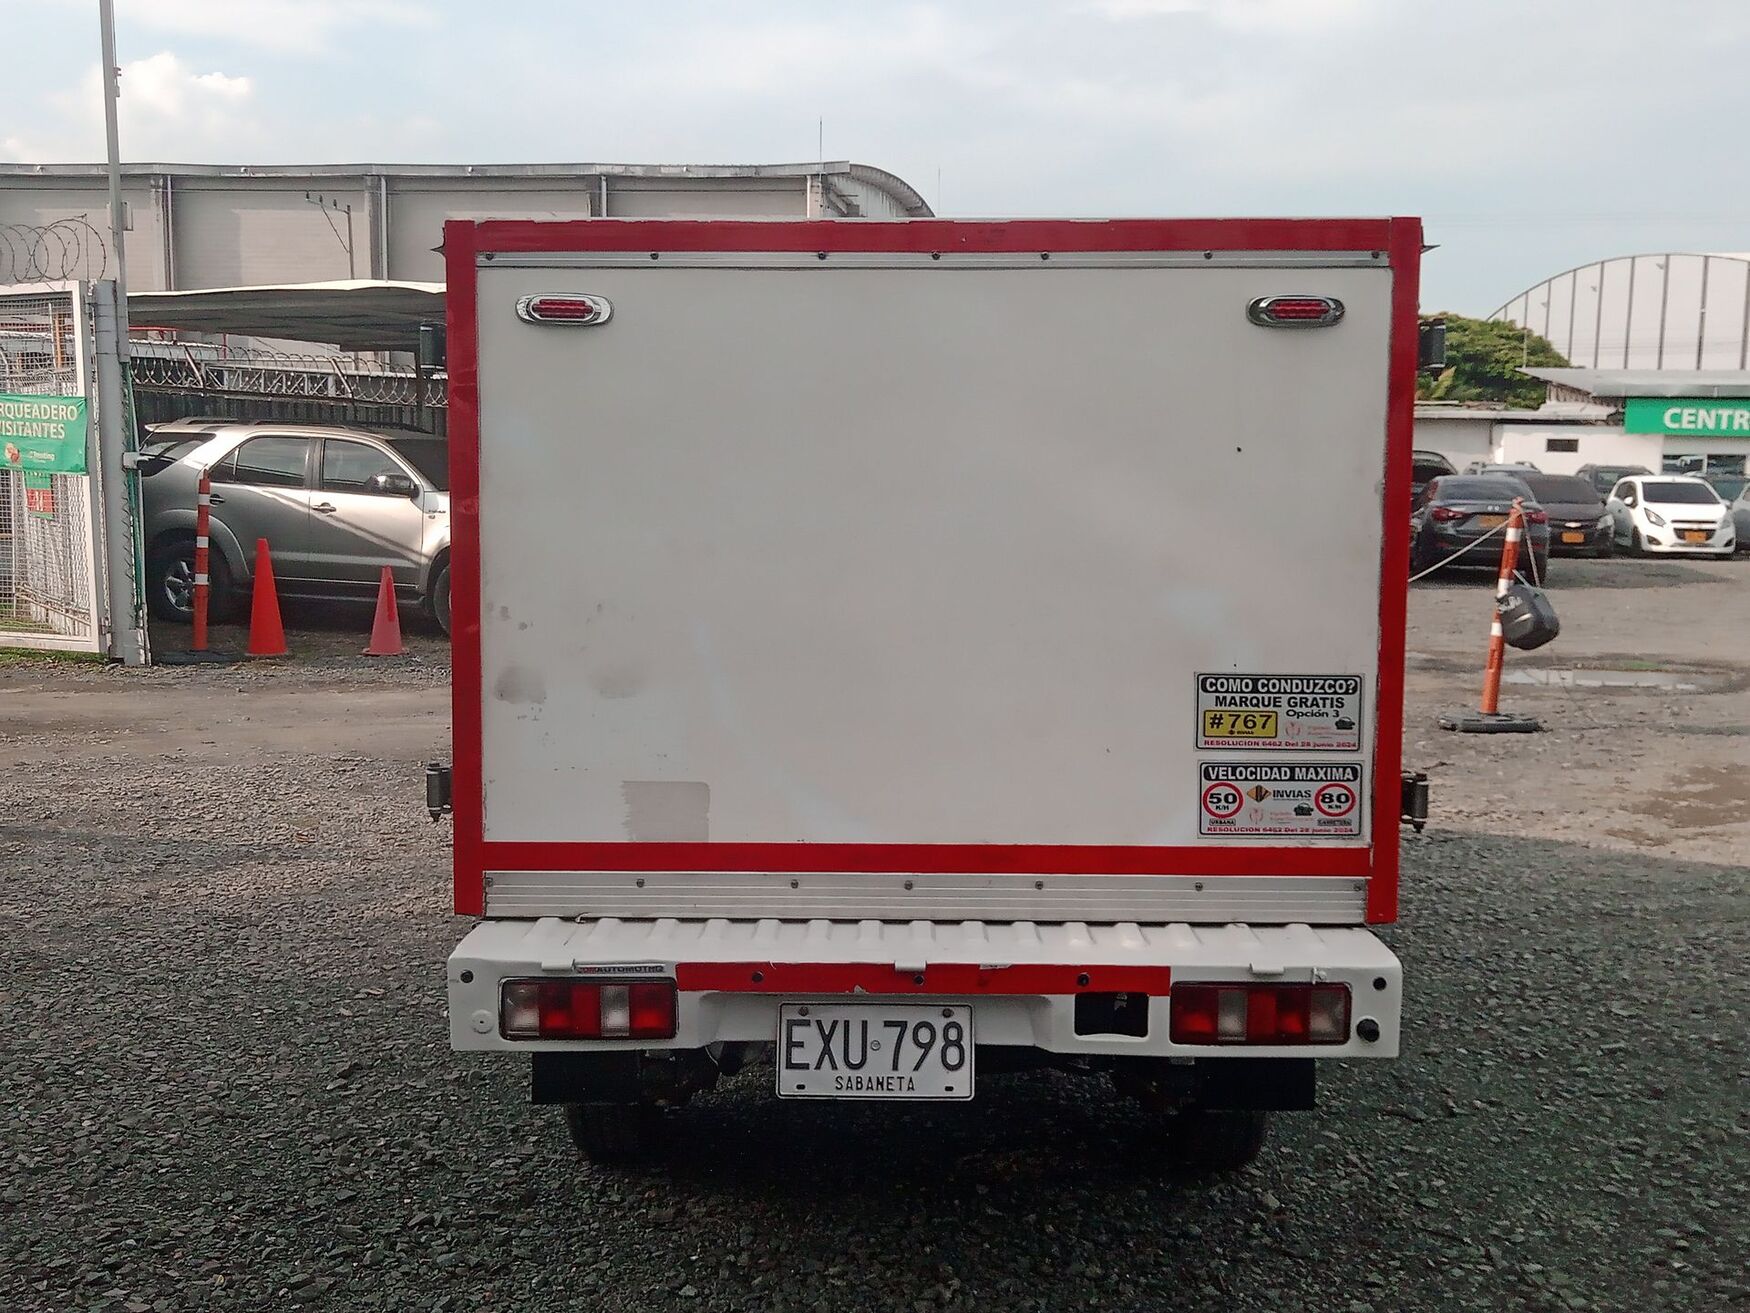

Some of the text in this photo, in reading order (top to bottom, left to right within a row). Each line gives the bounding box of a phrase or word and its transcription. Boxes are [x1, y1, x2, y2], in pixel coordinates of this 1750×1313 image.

[0, 420, 65, 439] ISITANTES
[1206, 678, 1356, 693] COMO CONDUZCO?
[1215, 695, 1345, 709] MARQUE GRATIS
[1286, 709, 1340, 719] Opción 3
[1204, 739, 1260, 747] RESOLUCION
[1208, 766, 1354, 781] VELOCIDAD MAXIMA
[1208, 793, 1238, 804] 50
[1273, 789, 1312, 798] INVIAS
[1320, 793, 1350, 804] 80
[785, 1019, 965, 1072] EXU 798
[835, 1076, 916, 1091] SABANETA
